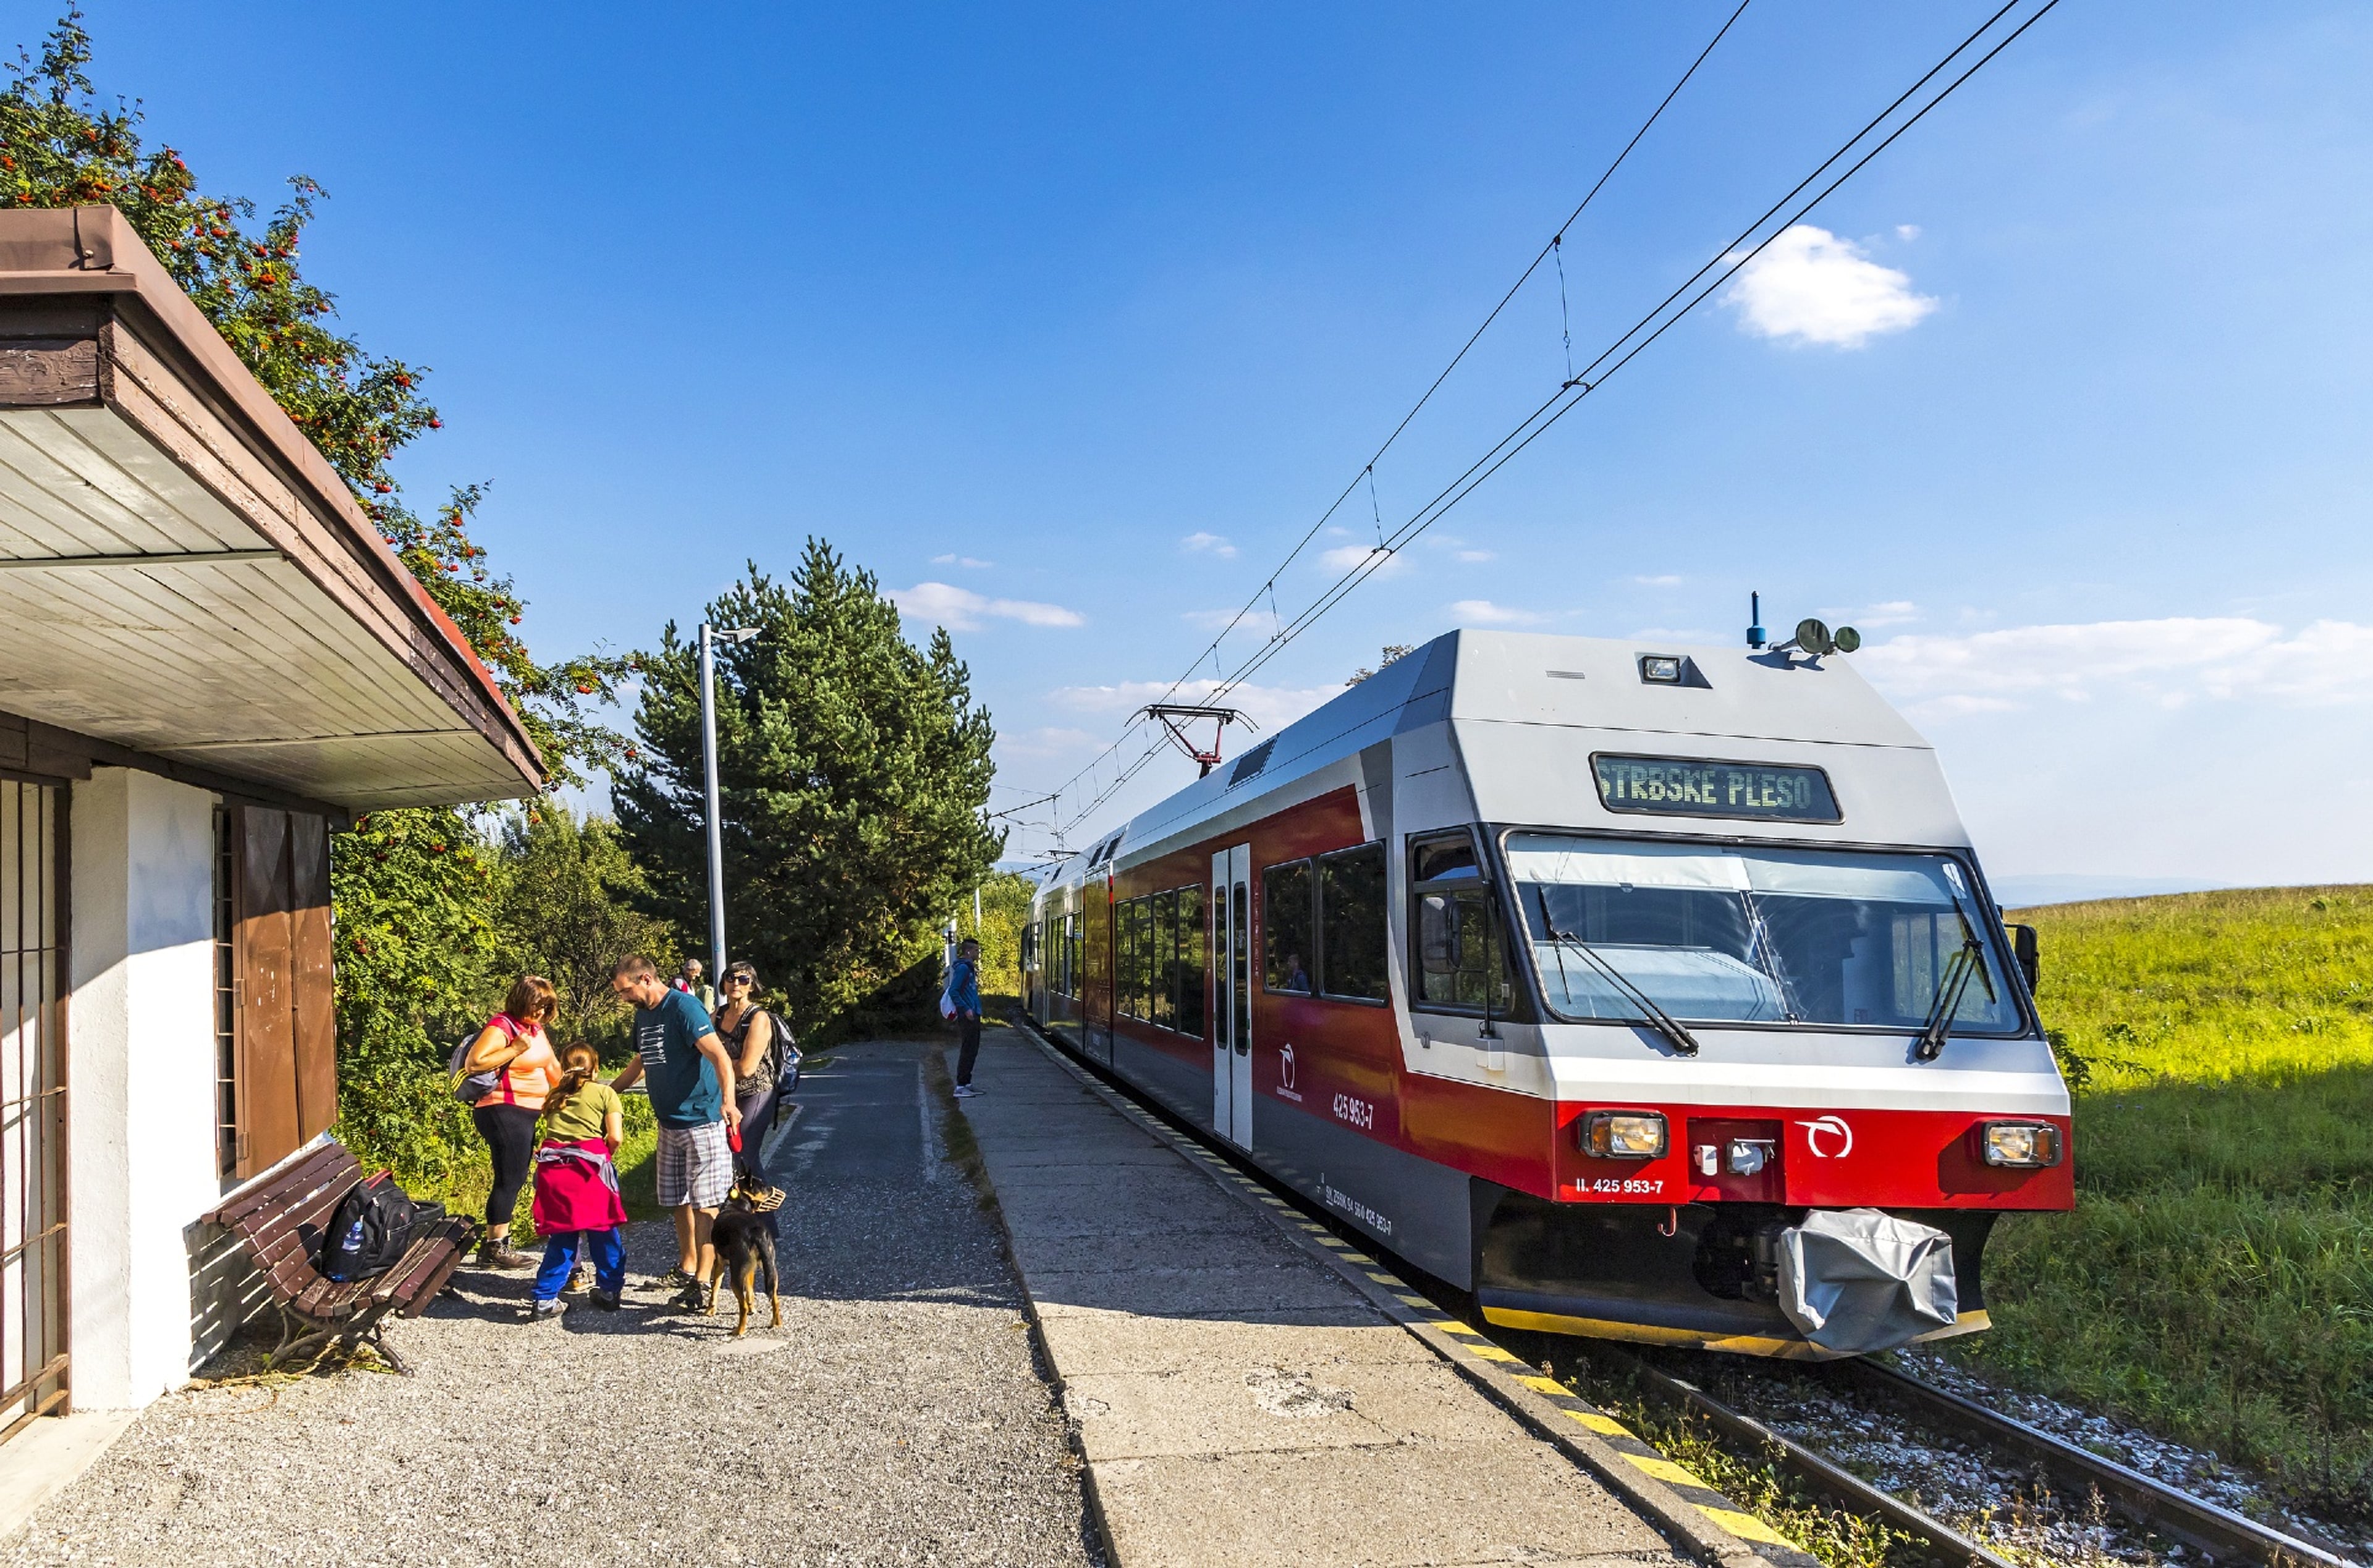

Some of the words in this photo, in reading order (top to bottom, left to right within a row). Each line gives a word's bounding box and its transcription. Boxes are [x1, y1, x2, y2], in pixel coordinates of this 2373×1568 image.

[1728, 772, 1811, 809] PLESO
[1334, 1092, 1348, 1120] 425
[1350, 1097, 1373, 1130] 953-7
[1593, 1178, 1620, 1192] 425
[1624, 1179, 1664, 1194] 953-7
